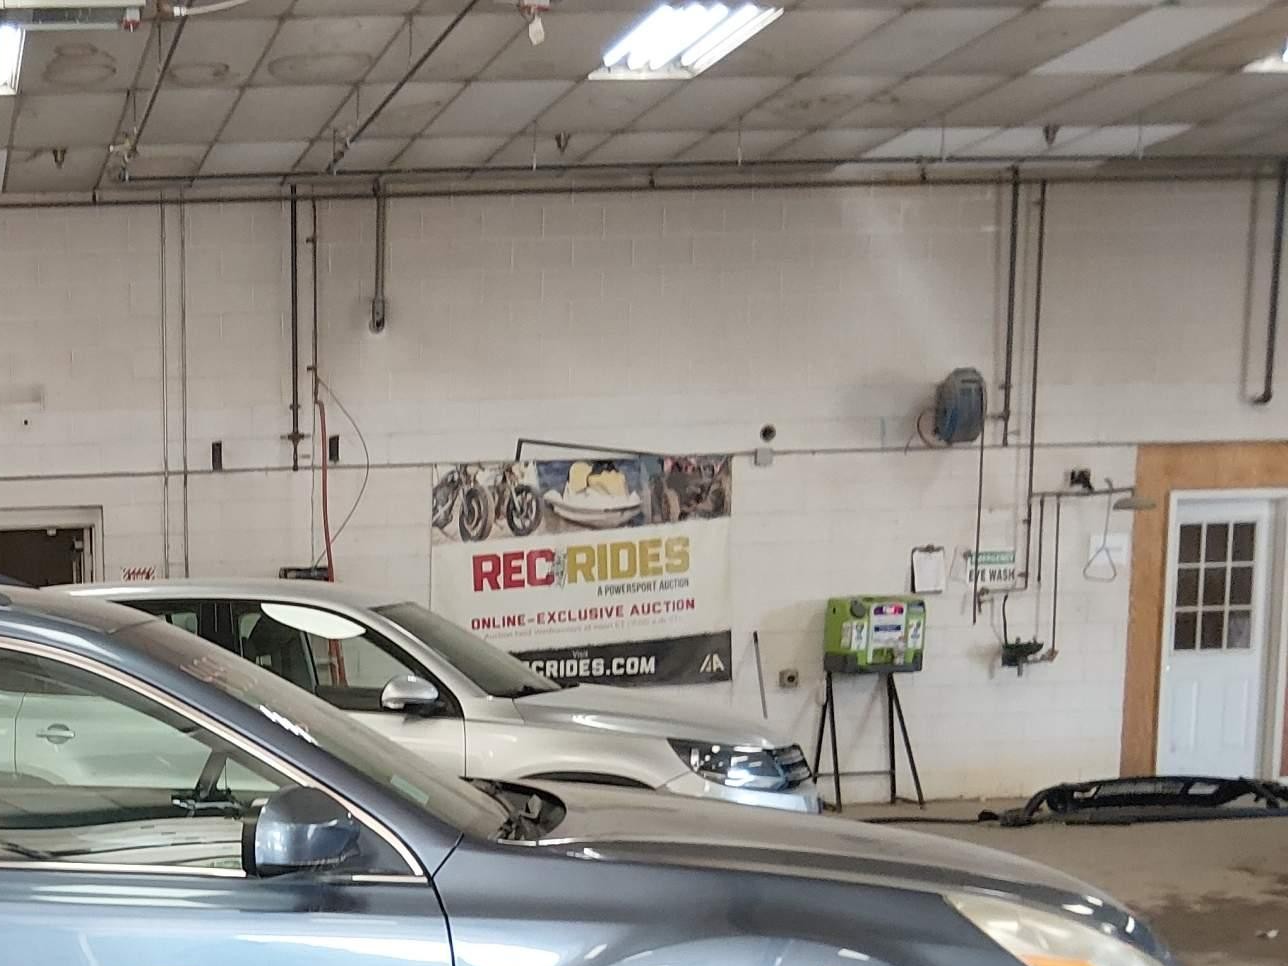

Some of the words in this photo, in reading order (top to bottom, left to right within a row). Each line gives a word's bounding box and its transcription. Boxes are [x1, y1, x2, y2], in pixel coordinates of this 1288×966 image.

[473, 549, 555, 591] REC
[567, 537, 690, 584] RIDES
[989, 567, 1015, 582] WASH
[597, 585, 603, 596] A
[604, 580, 656, 596] POWERSPORT
[659, 578, 689, 591] AUCTION
[471, 604, 625, 630] ONLINE-EXCLUSIVE
[630, 598, 696, 617] AUCTION
[527, 656, 656, 679] CRIDES.COM
